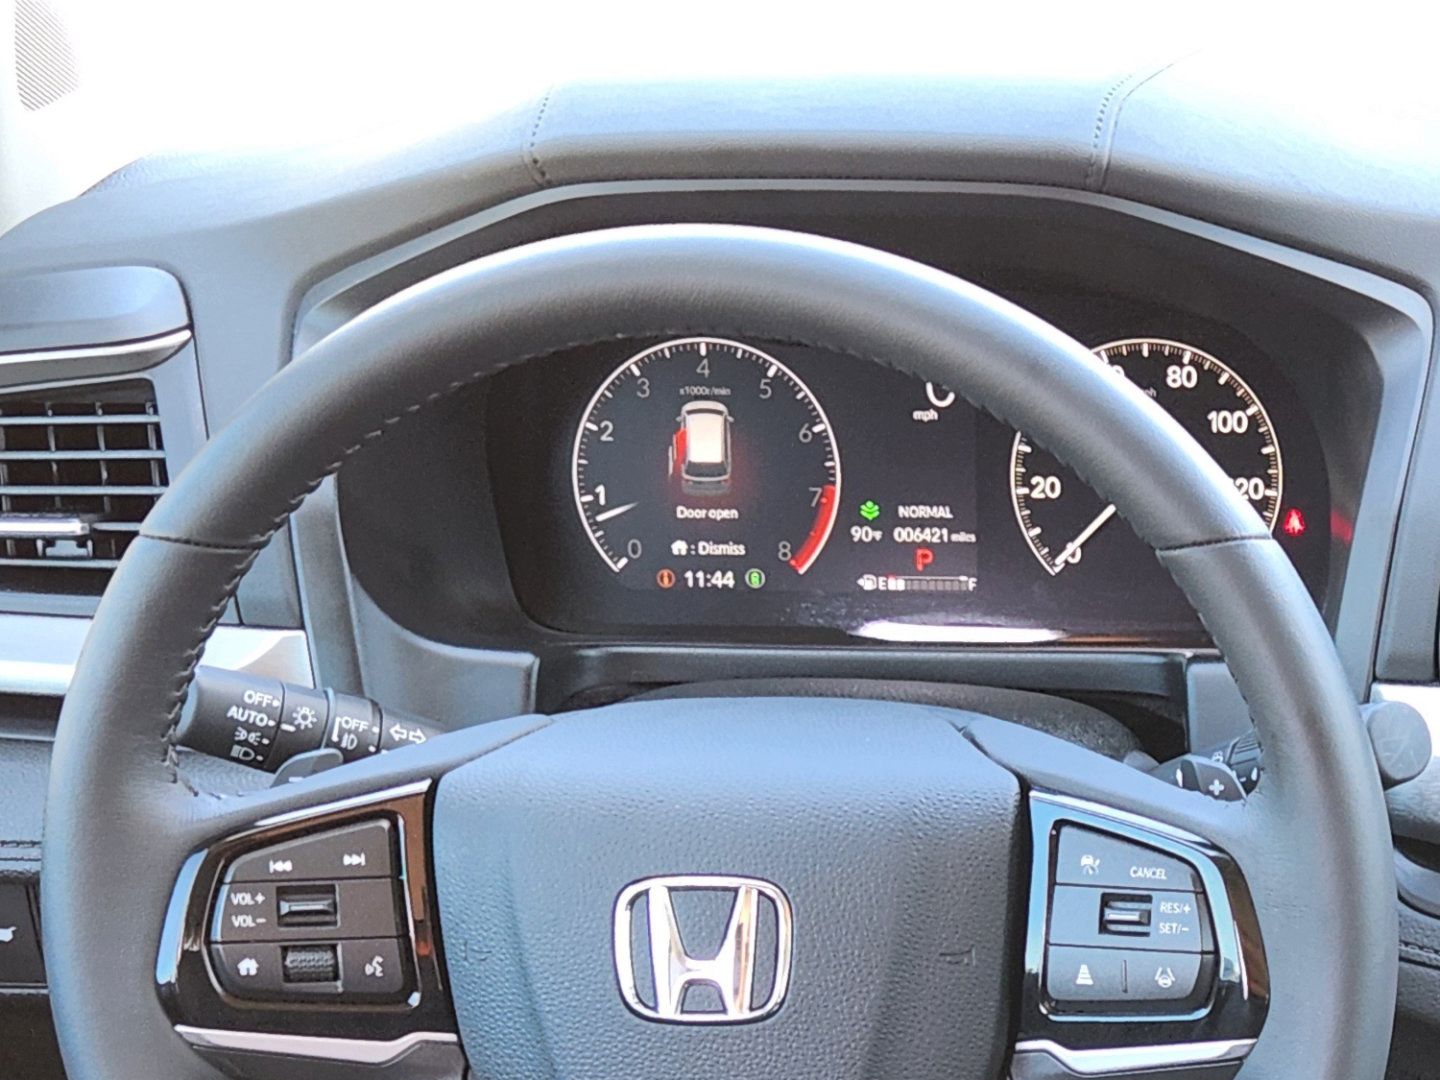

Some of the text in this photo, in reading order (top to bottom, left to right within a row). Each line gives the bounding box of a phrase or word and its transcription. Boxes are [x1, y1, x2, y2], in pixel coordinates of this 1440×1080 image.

[696, 358, 710, 378] 4
[1166, 365, 1198, 388] 80
[636, 378, 650, 398] 3
[759, 378, 772, 399] 5
[912, 408, 939, 422] mph
[1207, 410, 1248, 433] 100
[600, 421, 614, 442] 2
[798, 423, 813, 443] 6
[594, 485, 606, 506] 1
[808, 487, 822, 507] 7
[1030, 476, 1061, 499] 20
[676, 505, 739, 522] Door open
[898, 505, 954, 519] NORMAL
[893, 526, 949, 543] 006421
[627, 539, 642, 559] 0
[697, 541, 746, 556] Dismiss
[778, 541, 792, 561] 8
[914, 547, 934, 572] P
[684, 570, 736, 588] 11:44
[878, 577, 887, 590] E
[968, 577, 978, 591] F
[244, 690, 272, 707] OFF
[227, 706, 269, 726] AUTO
[341, 716, 369, 732] OFF
[1130, 866, 1167, 880] CANCEL
